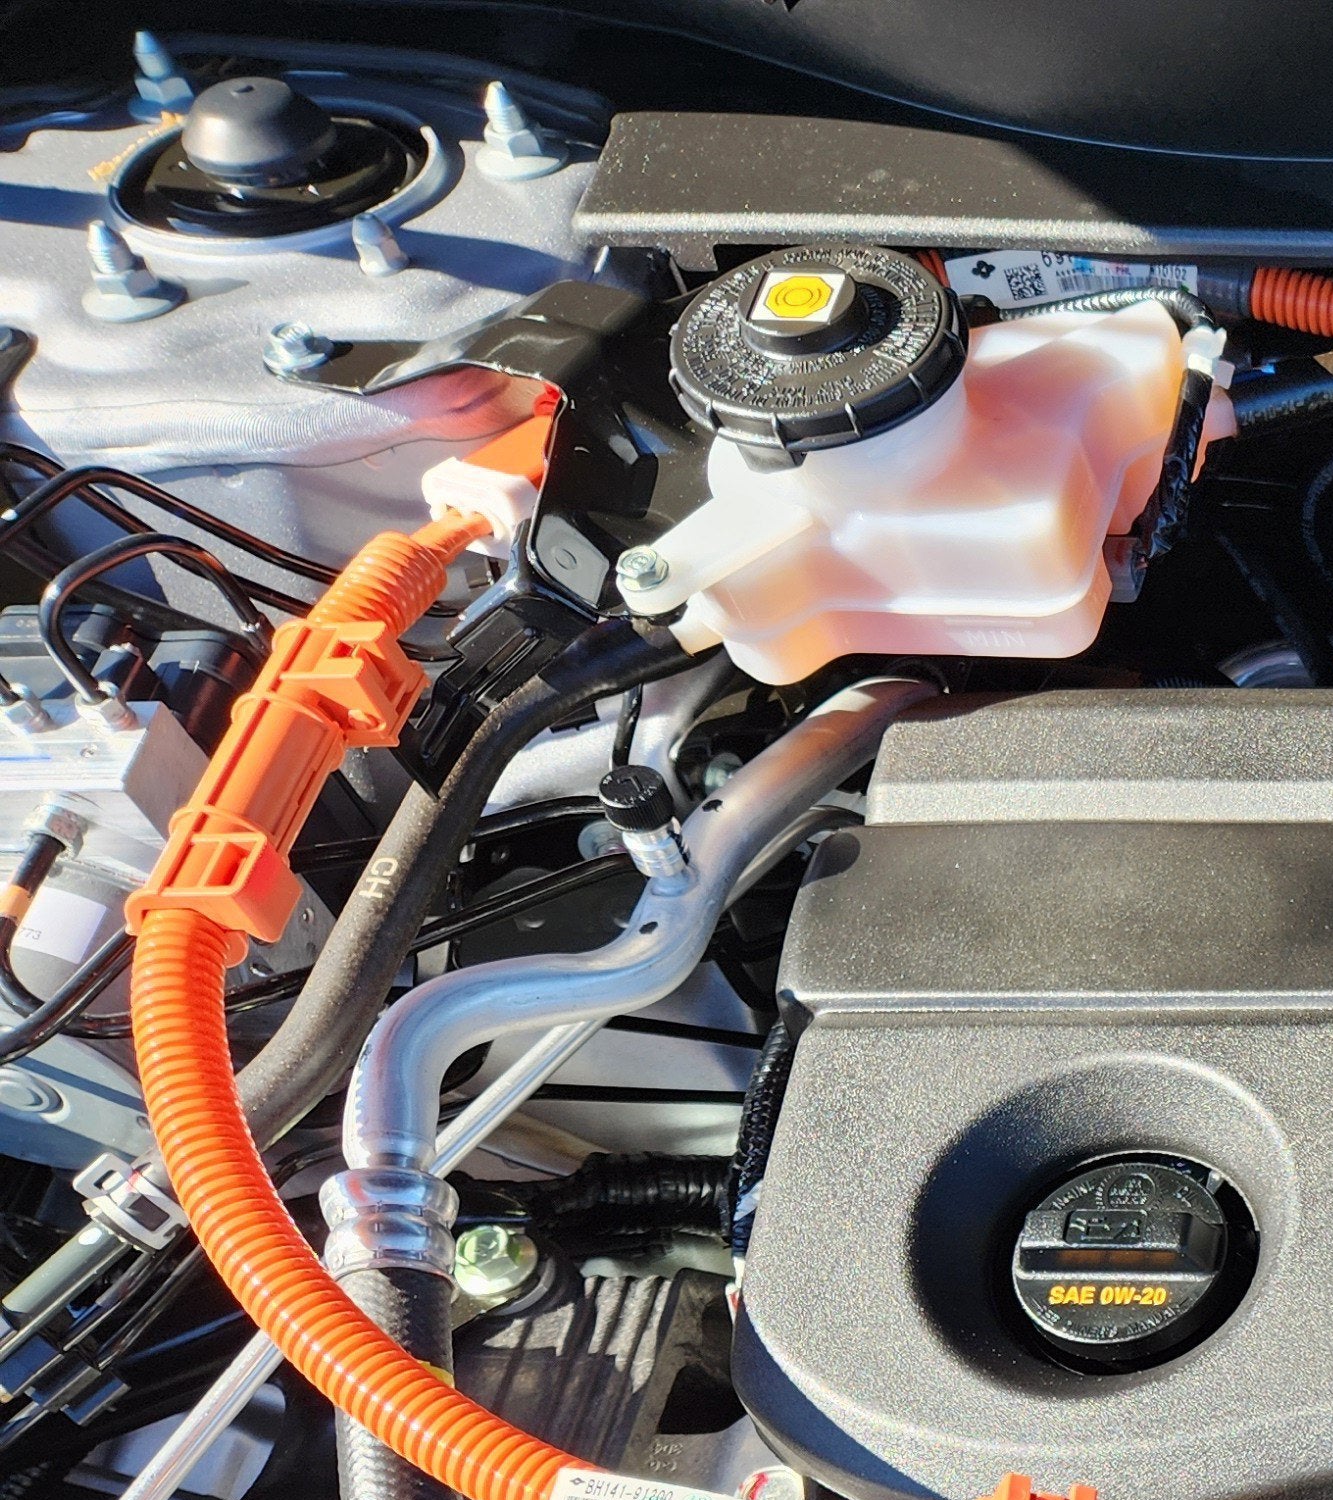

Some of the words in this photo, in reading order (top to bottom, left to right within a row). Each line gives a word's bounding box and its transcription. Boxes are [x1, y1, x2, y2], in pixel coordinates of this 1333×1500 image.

[359, 857, 398, 899] CH
[1048, 1285, 1096, 1306] SAE
[1100, 1285, 1168, 1306] 0W-20
